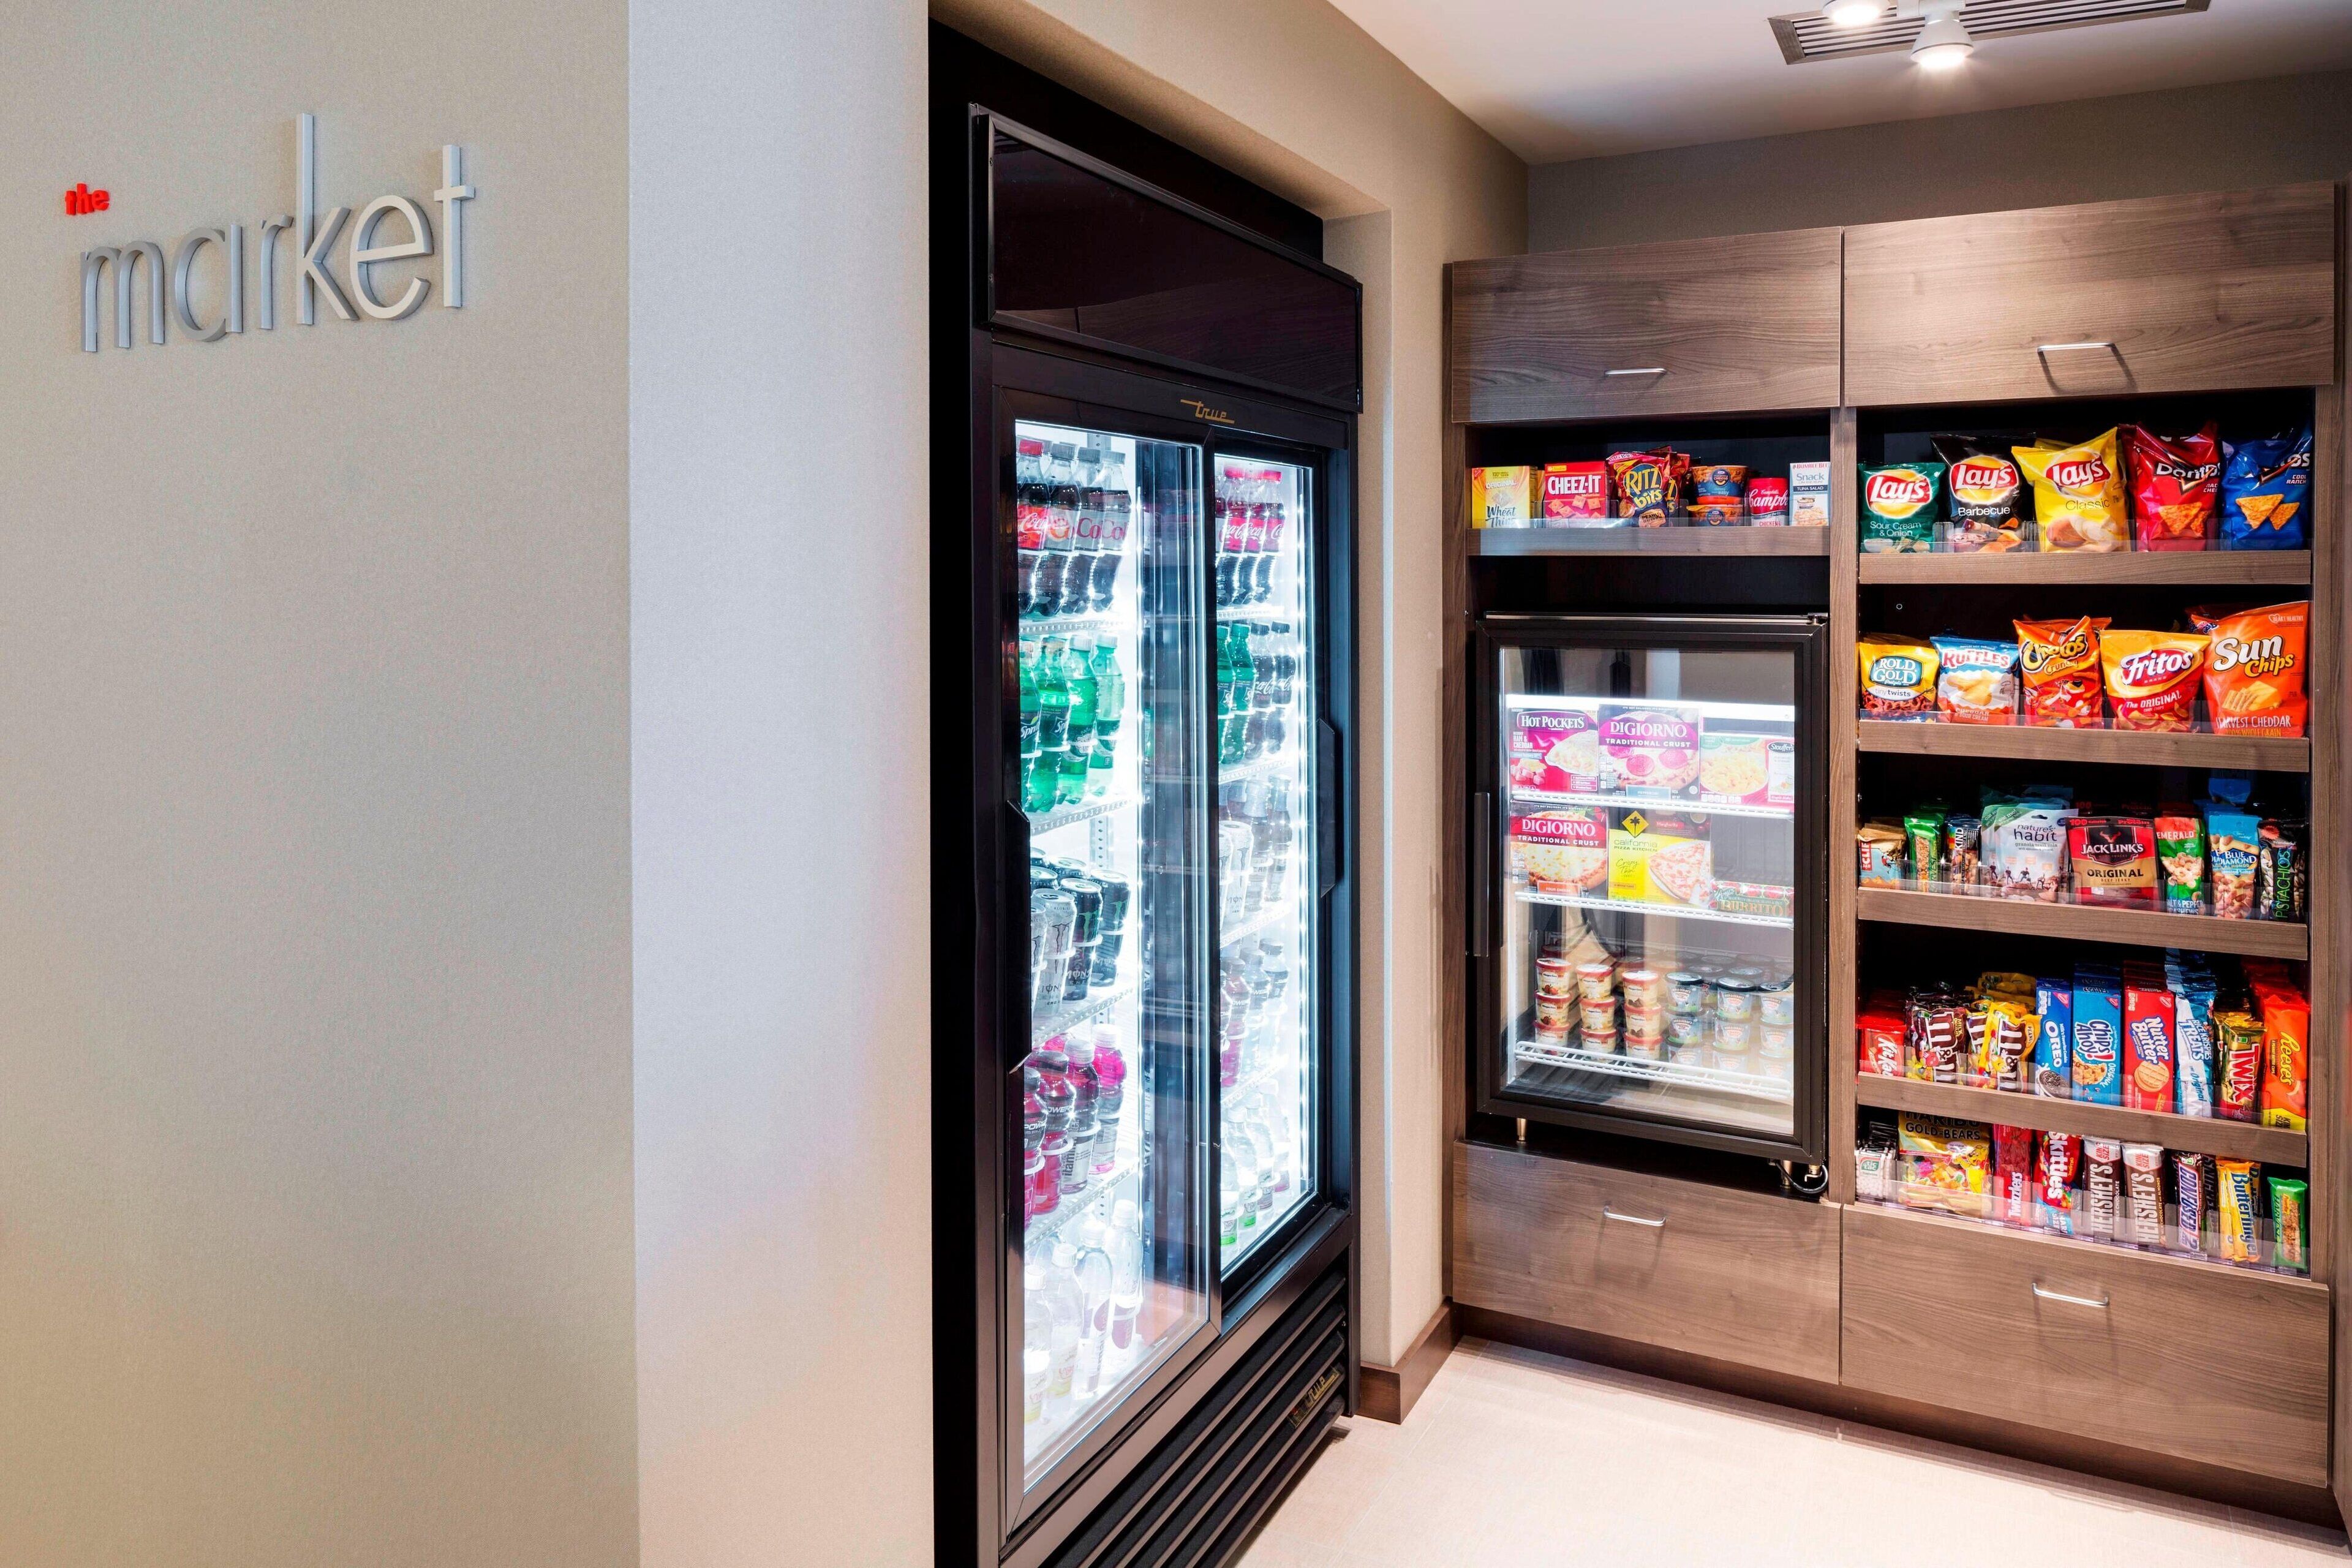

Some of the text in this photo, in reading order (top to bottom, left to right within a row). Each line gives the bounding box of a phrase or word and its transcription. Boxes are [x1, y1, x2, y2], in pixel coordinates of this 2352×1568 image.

[65, 183, 110, 216] the
[80, 113, 475, 352] market
[1180, 399, 1235, 424] true
[1547, 475, 1602, 496] CHEEZ-IT
[1625, 467, 1661, 497] RITZ
[1796, 472, 1825, 481] Snack
[1954, 463, 2013, 490] Lay's
[2052, 459, 2105, 489] Lay's
[1634, 489, 1663, 509] bits
[1869, 475, 1928, 503] Lay's
[1487, 504, 1517, 518] Wheat
[1958, 506, 2010, 517] Barbecue
[2065, 498, 2111, 511] Classic
[1870, 521, 1921, 530] Sour Cream
[1880, 657, 1916, 670] ROLD
[1943, 649, 2010, 668] RUFFLES
[2212, 635, 2283, 672] Sun
[1873, 668, 1918, 685] GOLD
[2119, 650, 2194, 685] Fritos
[2244, 654, 2294, 677] Chips
[1887, 687, 1911, 697] twists
[2140, 690, 2182, 708] ORIGINAL
[1521, 715, 1585, 729] HOT POCKETS
[2215, 715, 2291, 729] HARVEST CHEDDAR
[2261, 728, 2282, 737] GRAIN
[1605, 737, 1660, 747] TRADITIONAL
[1517, 834, 1570, 845] TRADITIONAL
[1613, 838, 1657, 848] california
[1954, 827, 1964, 850] KIND
[2013, 828, 2057, 842] habit
[2156, 831, 2194, 840] EMERALD
[2081, 843, 2144, 854] JACK LINK'S
[2219, 855, 2257, 865] DIAMOND
[2225, 851, 2245, 859] BLUE
[2087, 869, 2144, 878] ORIGINAL
[2275, 849, 2291, 918] PISTACHIOS
[2044, 1020, 2062, 1068] OREO
[2089, 1019, 2114, 1054] Chips
[2131, 1022, 2158, 1065] Butter
[2145, 1016, 2169, 1060] Nutter
[2178, 1019, 2203, 1060] TREATS
[2192, 1019, 2212, 1060] RICE KRISPIES
[2229, 1043, 2260, 1104] TWIX
[2190, 1072, 2207, 1102] Original
[2283, 1117, 2291, 1128] KIN
[2047, 1131, 2068, 1199] Skittles
[2008, 1171, 2023, 1218] Twizzlers
[2089, 1163, 2113, 1234] HERSHEY'S
[2179, 1166, 2198, 1232] CONFUSED
[2130, 1172, 2159, 1243] HERSHEY'S
[2230, 1172, 2258, 1256] Butterfinger
